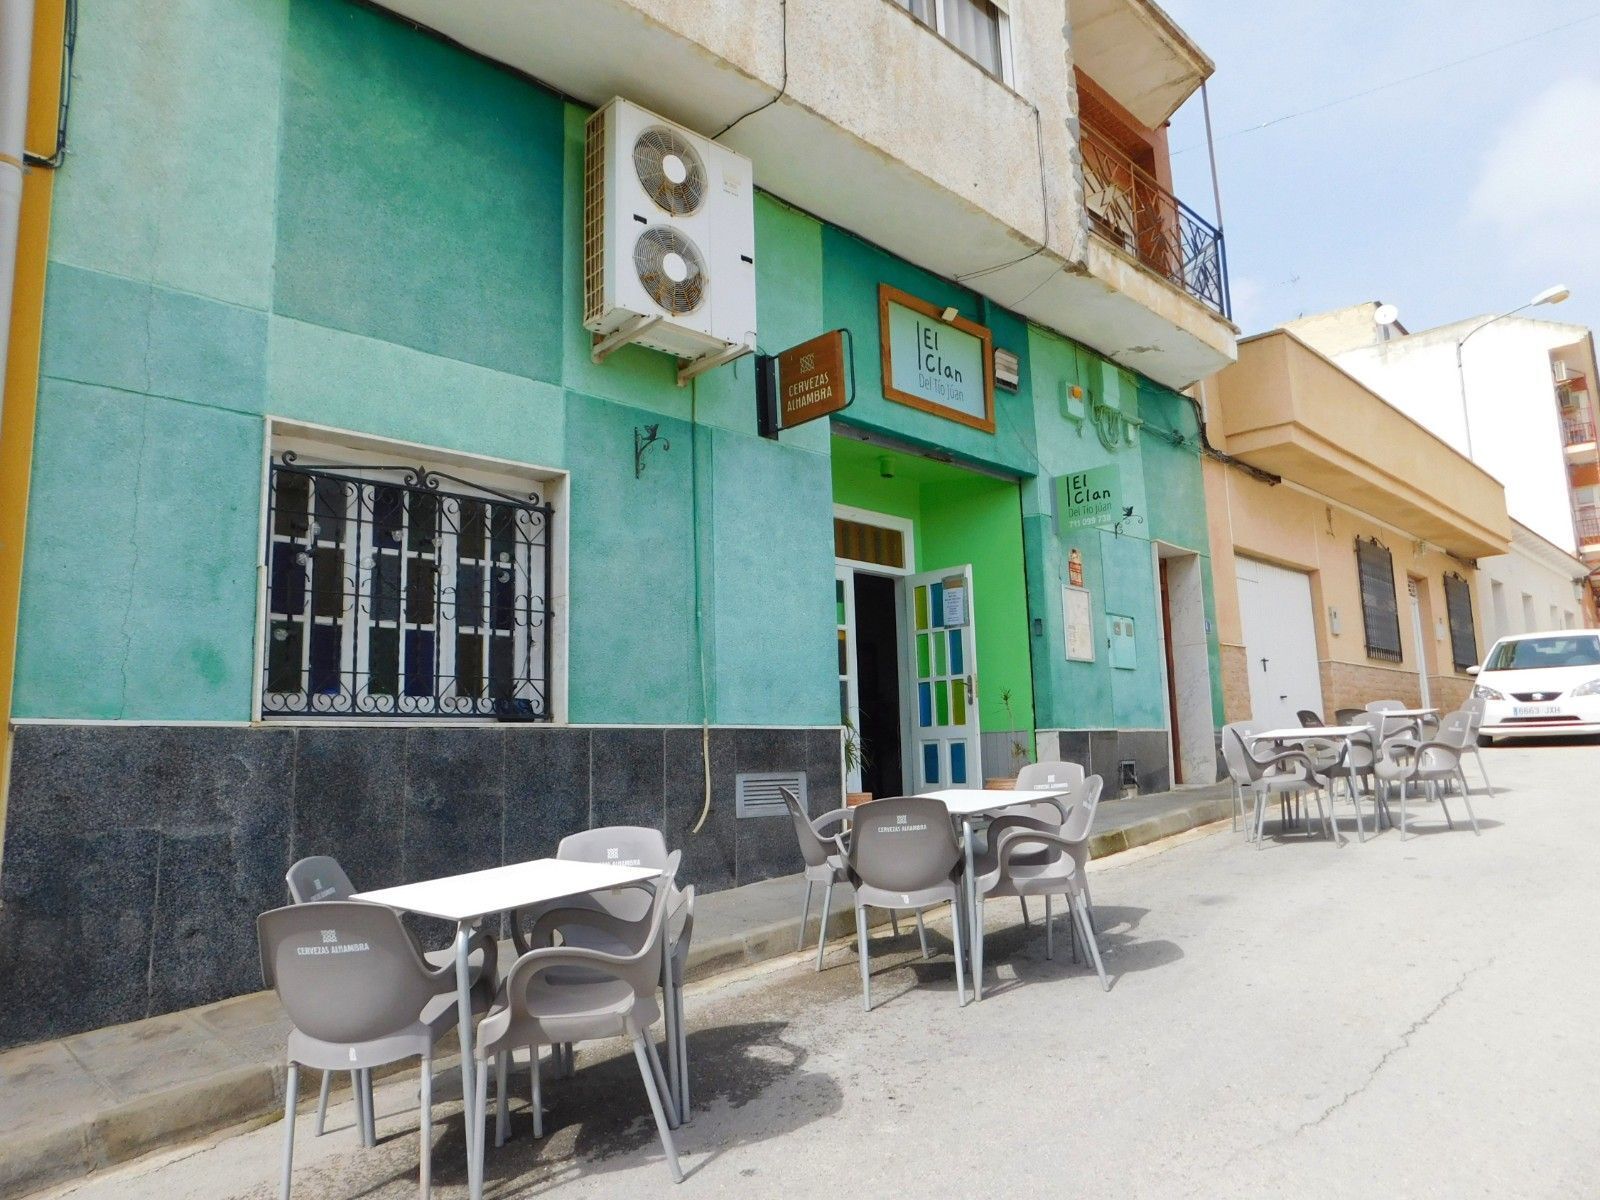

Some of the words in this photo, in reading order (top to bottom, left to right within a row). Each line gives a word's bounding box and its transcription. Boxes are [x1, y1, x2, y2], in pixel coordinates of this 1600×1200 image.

[924, 328, 938, 350] El
[925, 354, 963, 383] Clan
[788, 371, 830, 397] CERVEZAS
[919, 373, 932, 391] Del
[787, 386, 833, 412] ALHAMBRA
[1073, 474, 1087, 490] El
[1074, 489, 1111, 504] Clan
[1068, 507, 1081, 517] Del
[877, 825, 901, 833] CERVEZAS
[297, 946, 330, 956] CERVEZAS
[331, 942, 370, 953] ALHAMBRA
